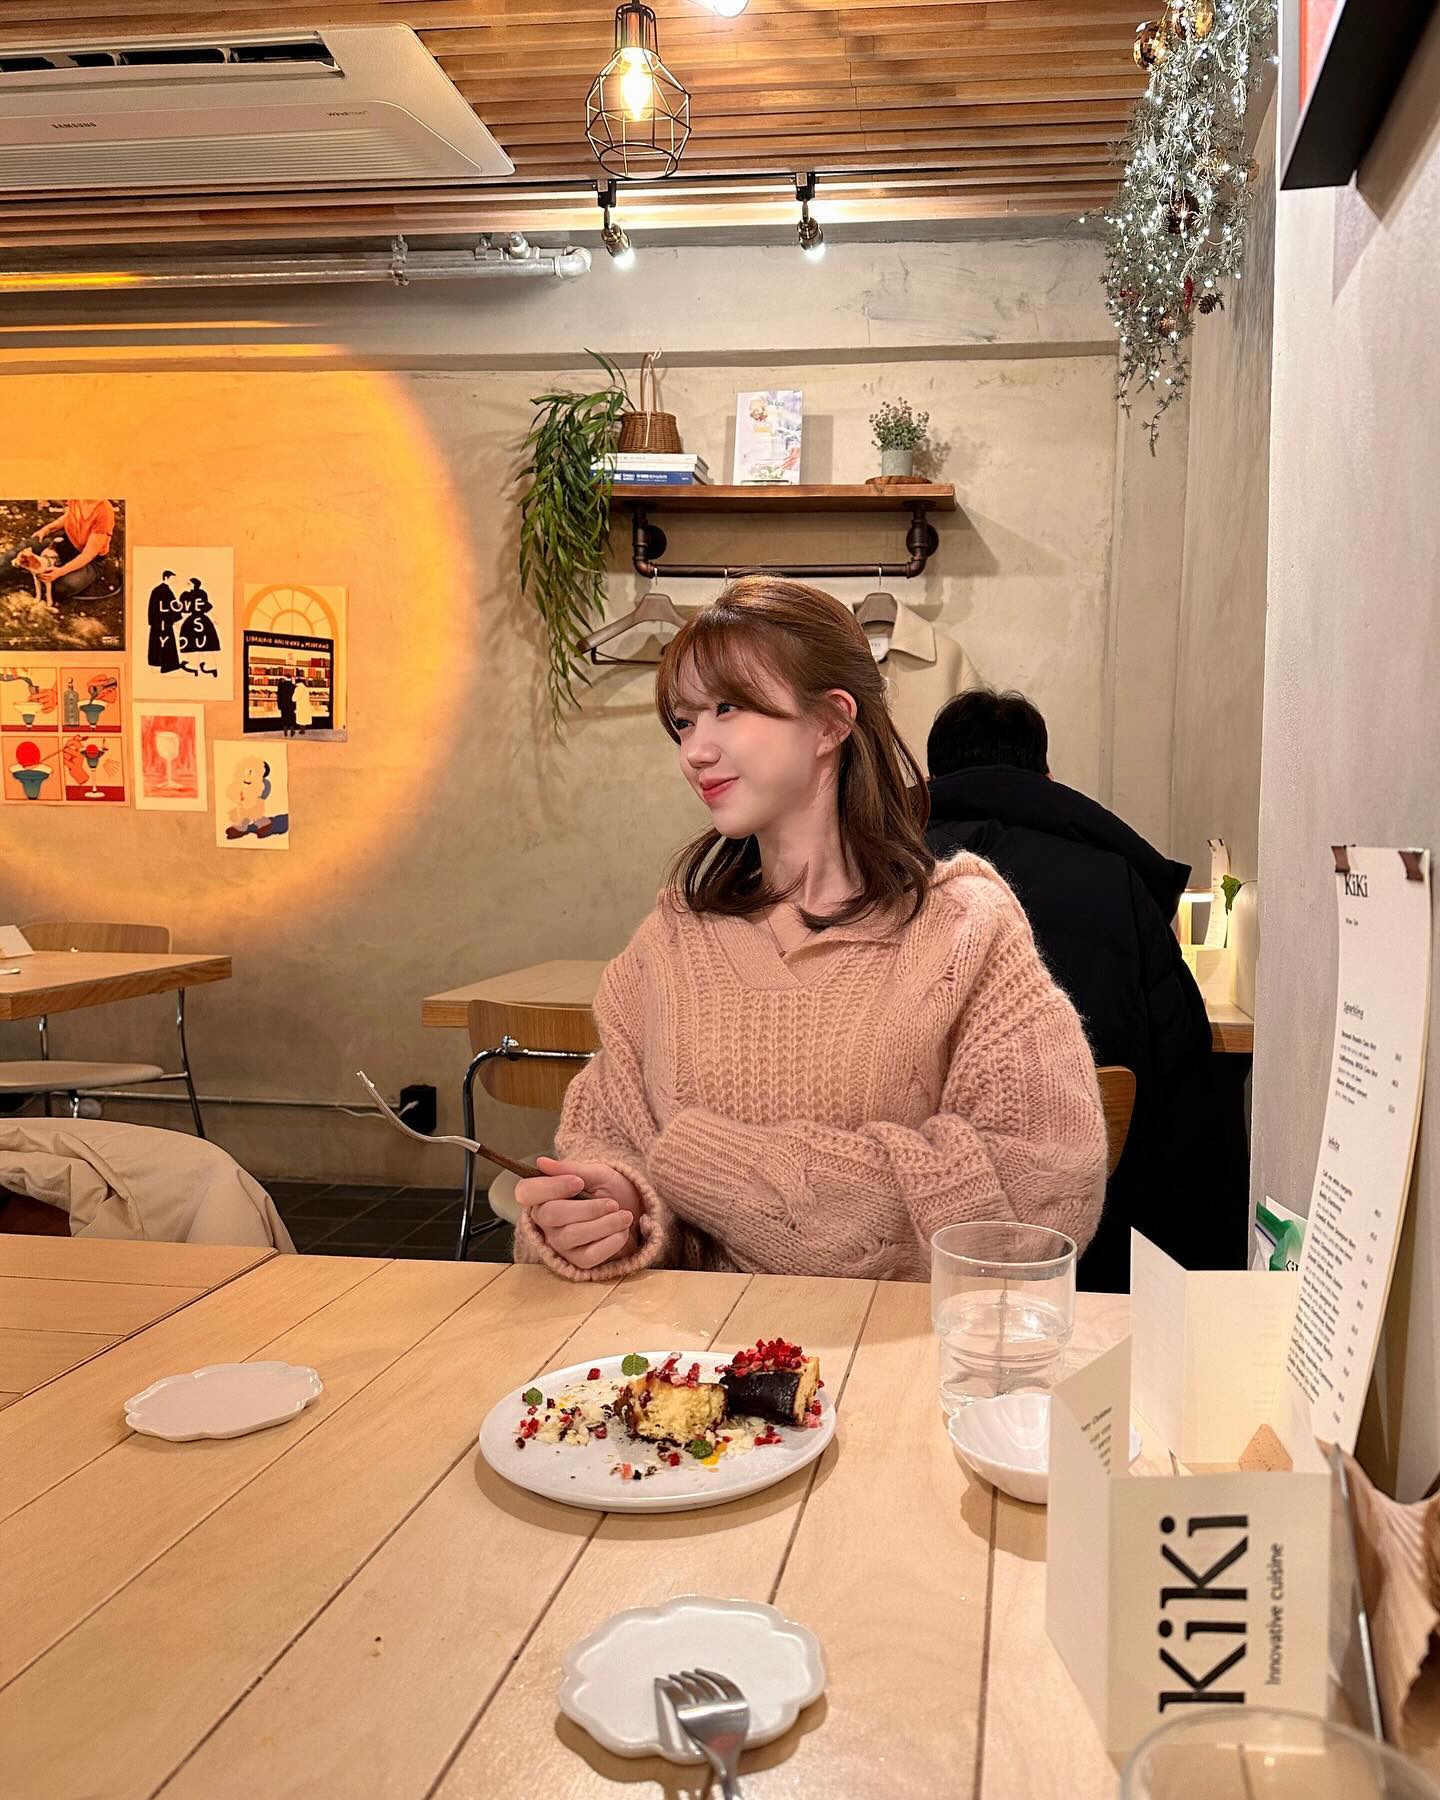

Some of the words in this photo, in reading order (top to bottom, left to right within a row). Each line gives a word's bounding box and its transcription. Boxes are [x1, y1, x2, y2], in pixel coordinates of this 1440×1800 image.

[159, 597, 205, 613] LOVE
[159, 634, 207, 650] YOU
[1344, 872, 1368, 898] KiKi
[1266, 1543, 1284, 1601] cuisine
[1158, 1515, 1249, 1714] KiKi
[1265, 1605, 1284, 1686] Innovative
